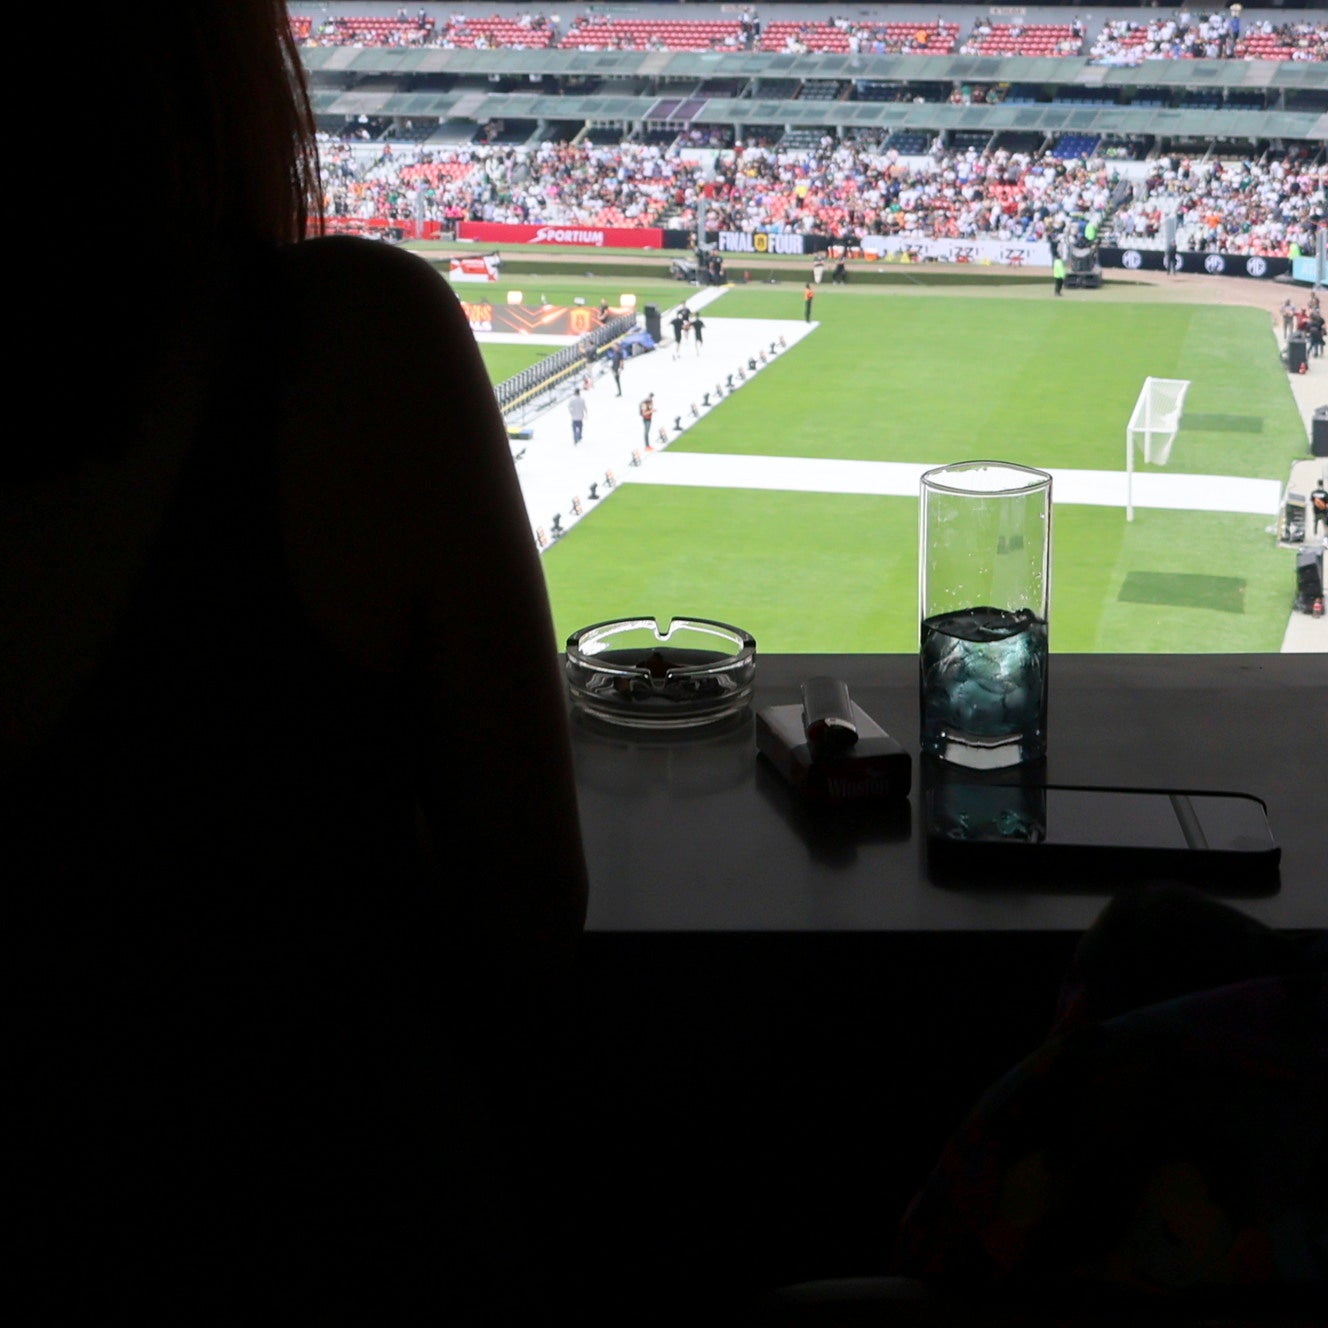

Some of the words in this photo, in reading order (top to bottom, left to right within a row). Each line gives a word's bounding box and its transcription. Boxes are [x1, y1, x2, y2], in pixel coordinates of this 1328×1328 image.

[529, 227, 605, 244] SPORTIUM
[719, 231, 754, 252] FINAL
[768, 233, 804, 254] FOUR
